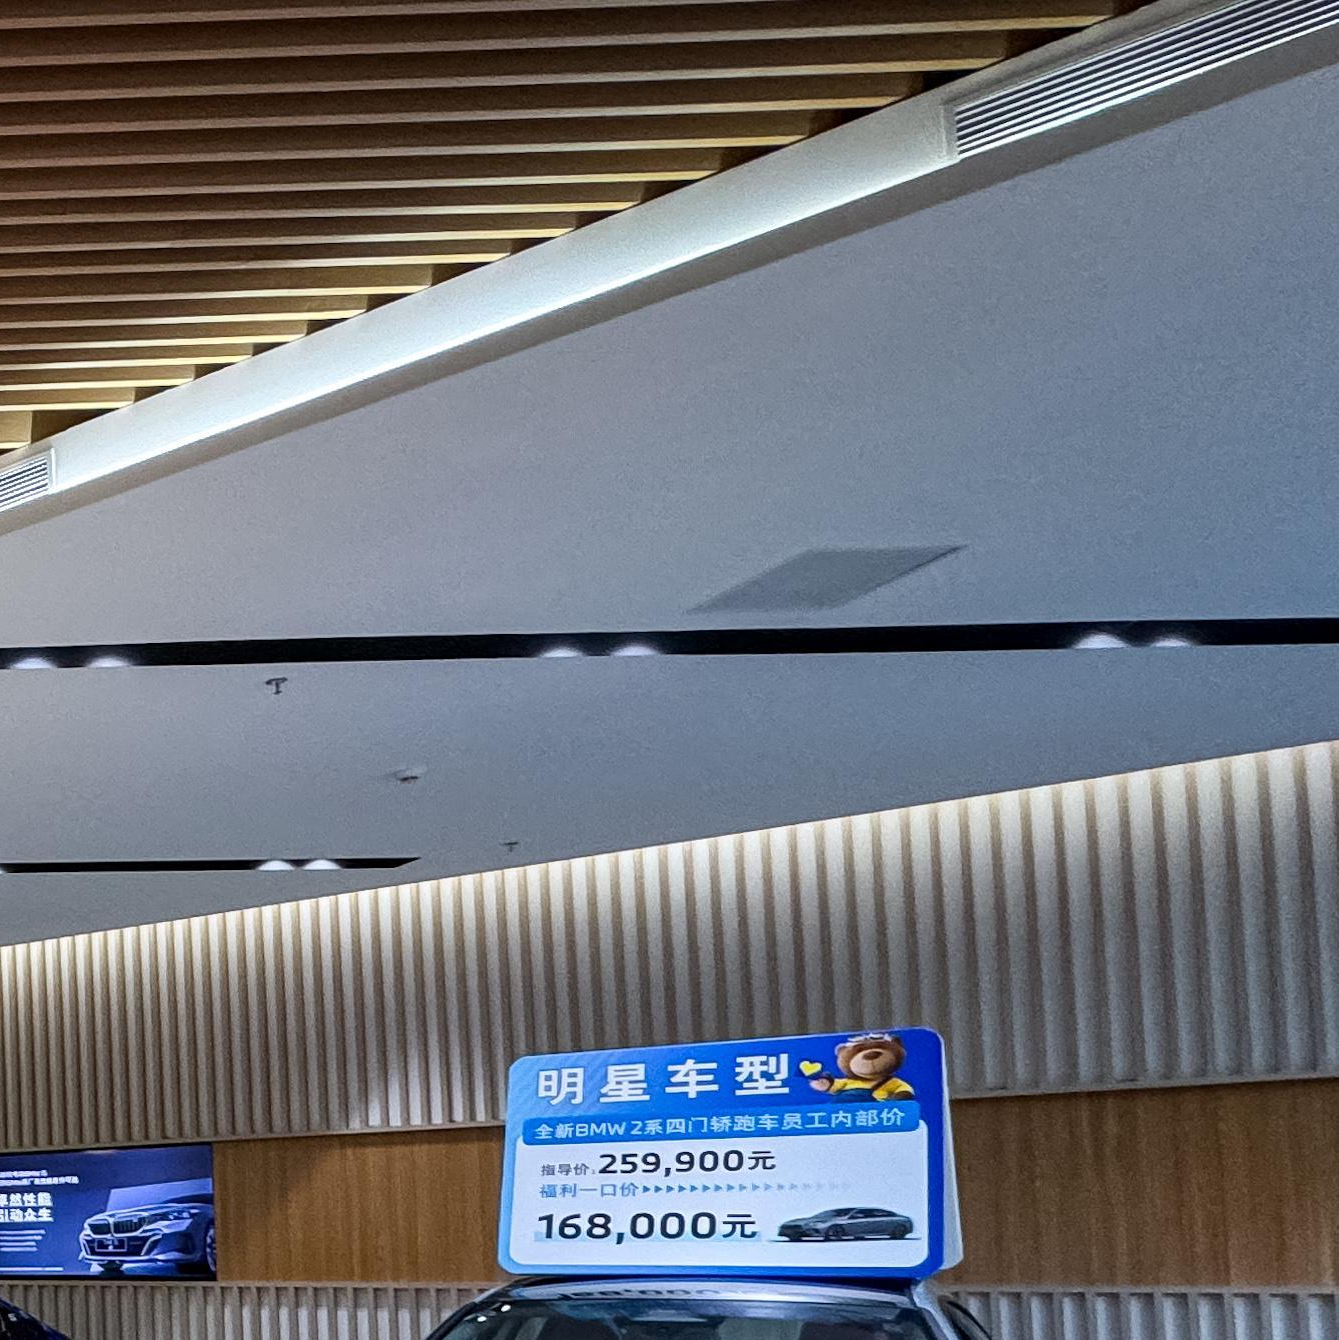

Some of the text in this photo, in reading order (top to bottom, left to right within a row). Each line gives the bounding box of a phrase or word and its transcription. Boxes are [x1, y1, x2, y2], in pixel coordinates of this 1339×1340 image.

[537, 1053, 790, 1105] 明星车型
[539, 1181, 640, 1198] 福利一口价
[537, 1211, 758, 1245] 168,000元
